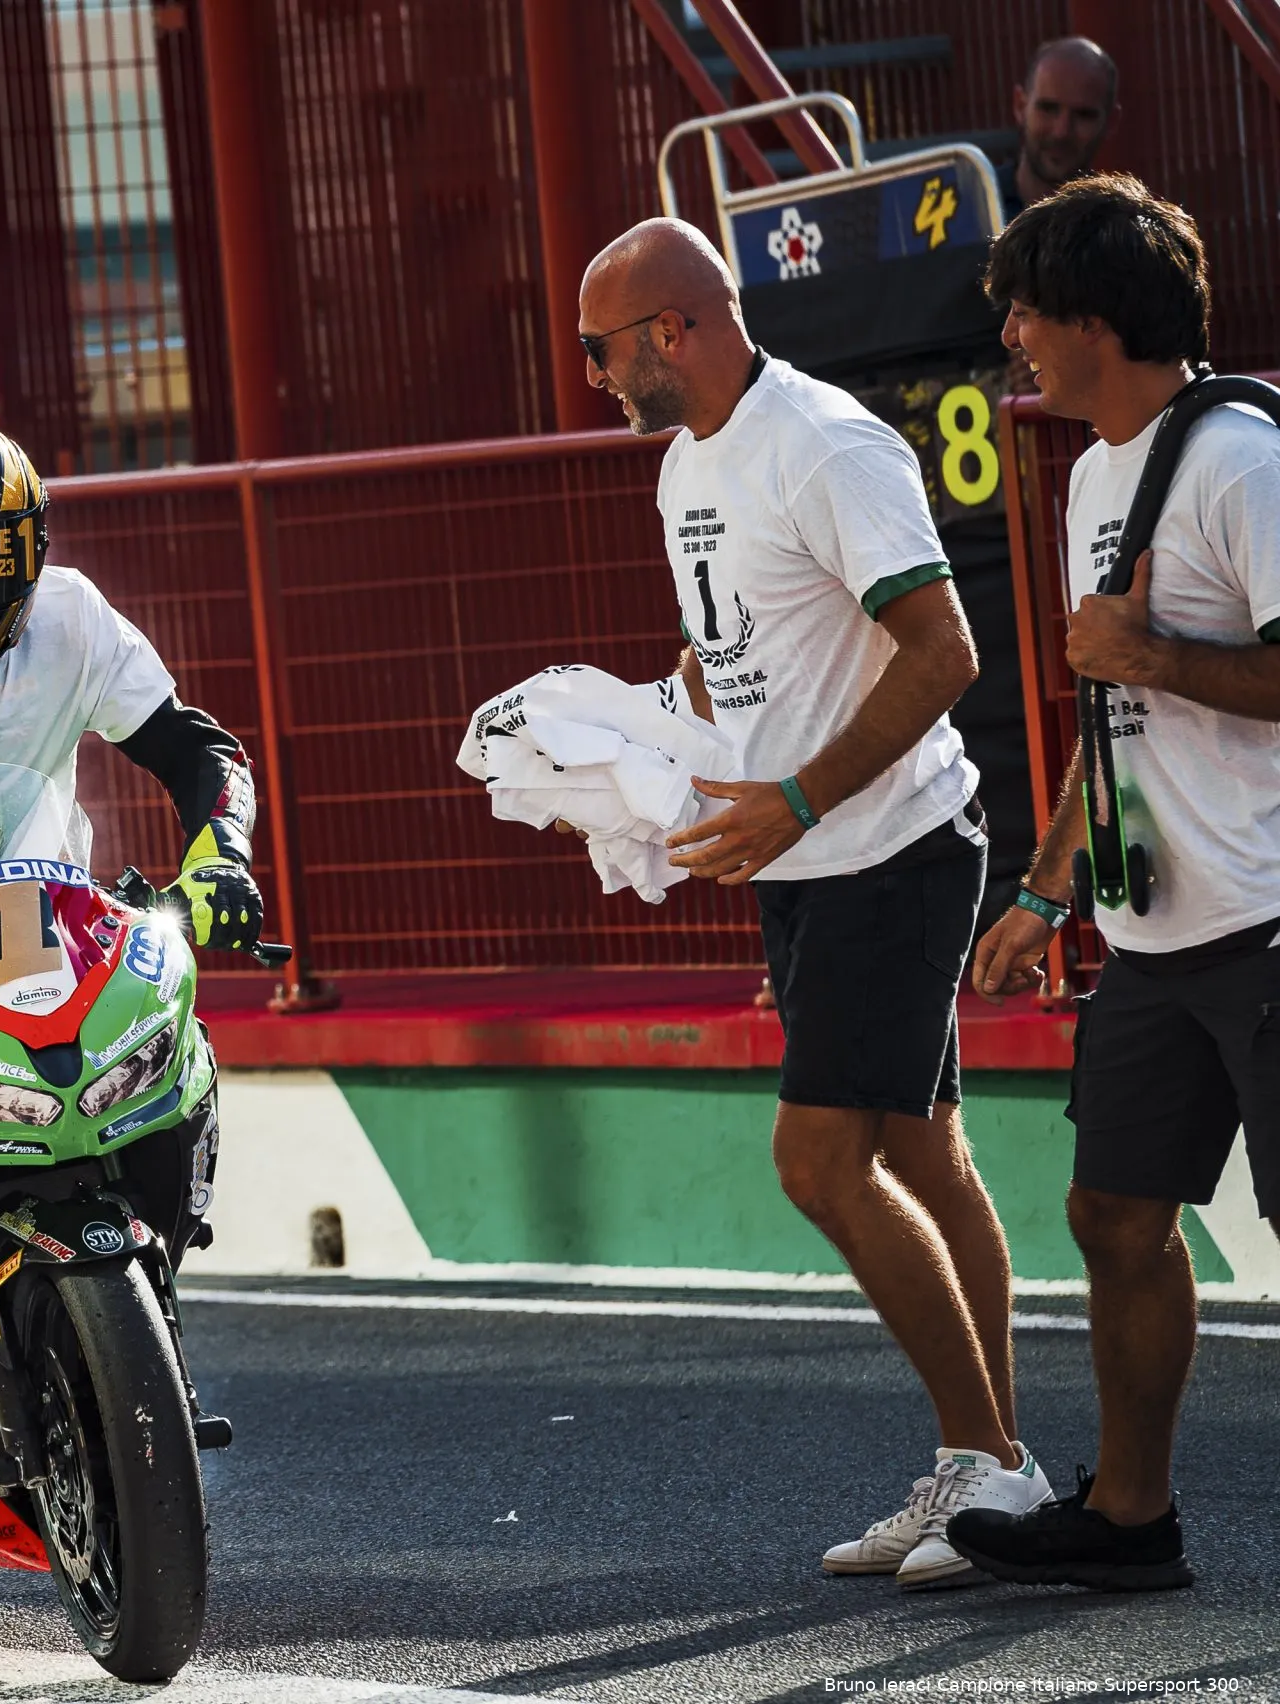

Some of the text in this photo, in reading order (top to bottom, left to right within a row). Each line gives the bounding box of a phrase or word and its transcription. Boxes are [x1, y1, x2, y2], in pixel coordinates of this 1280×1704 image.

[938, 384, 1000, 506] 8
[694, 560, 722, 641] 1
[713, 687, 767, 710] awasaki
[16, 987, 58, 1002] domino
[86, 1230, 121, 1247] STM
